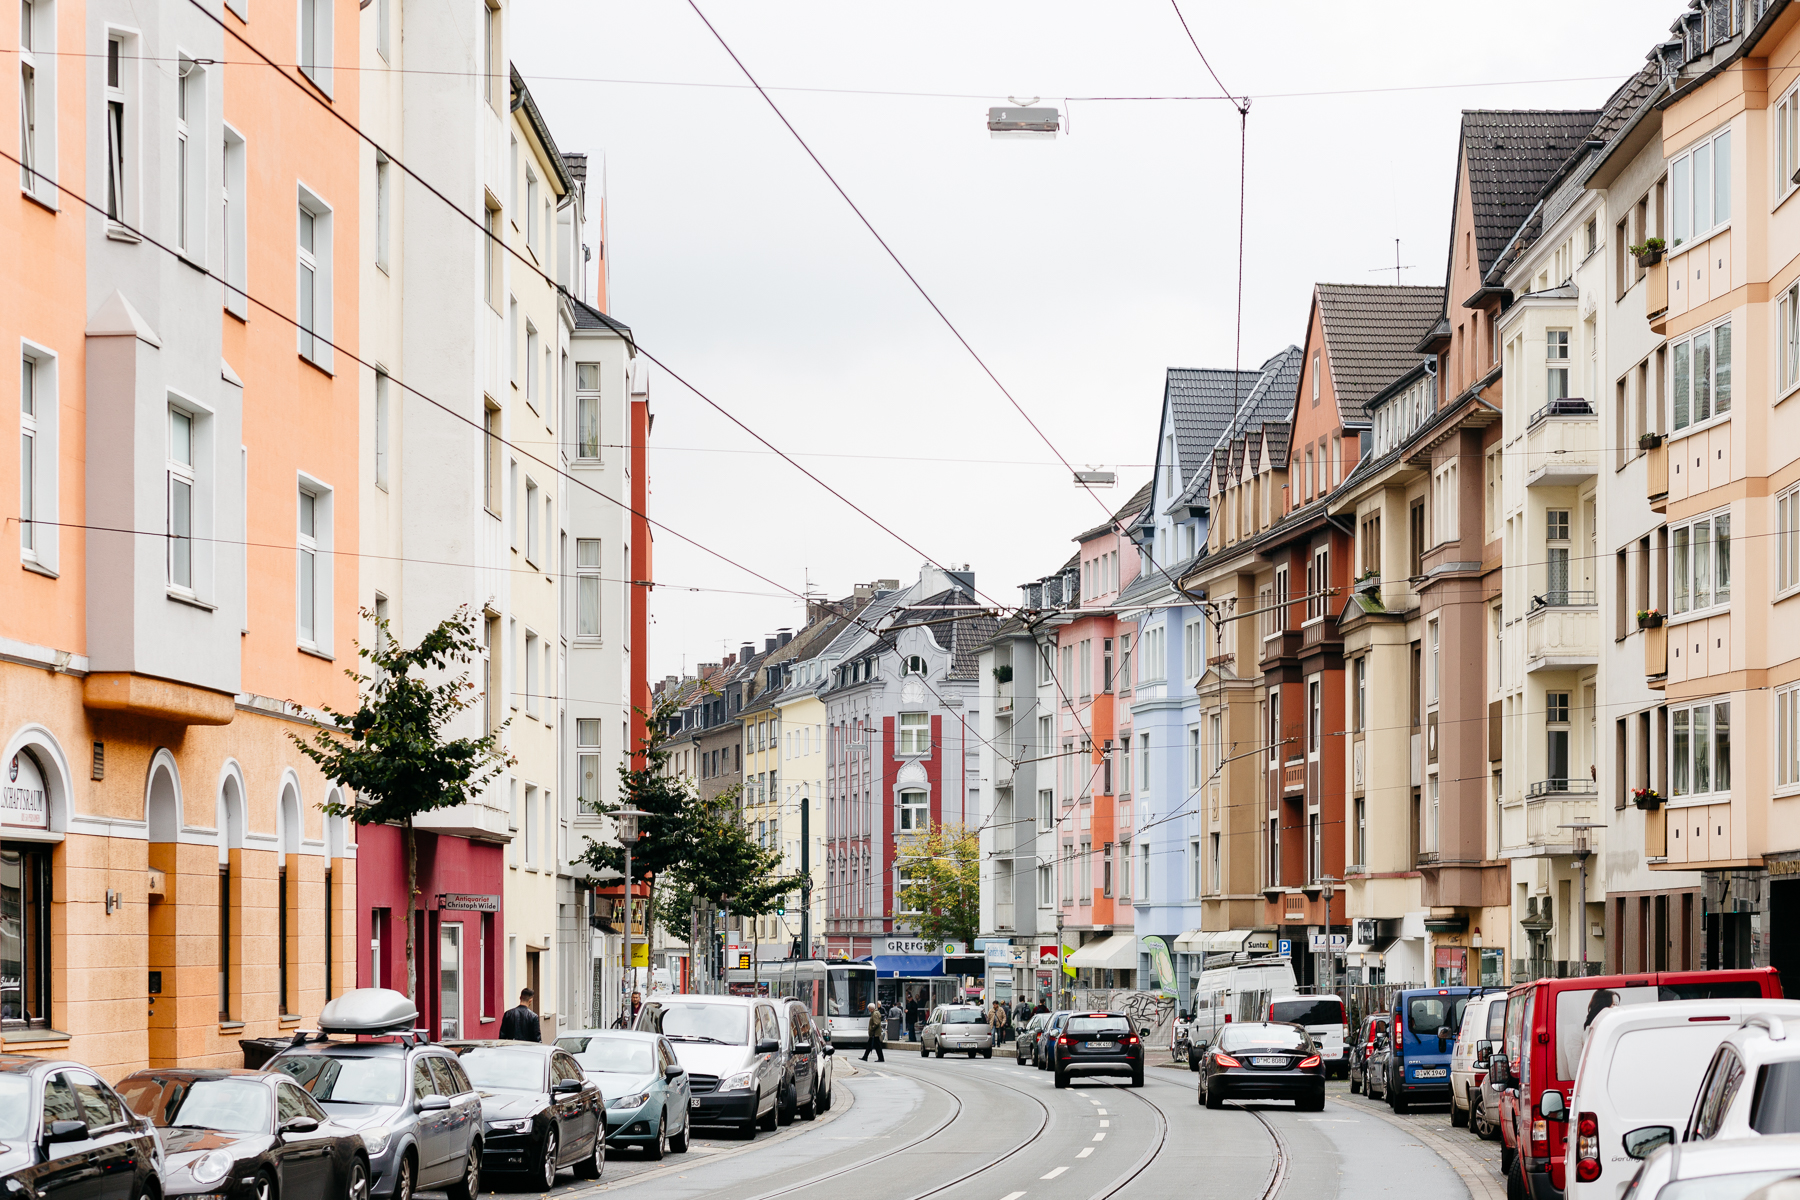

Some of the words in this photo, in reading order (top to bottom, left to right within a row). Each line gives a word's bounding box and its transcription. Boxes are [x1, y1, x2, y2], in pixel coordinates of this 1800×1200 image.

[455, 895, 489, 903] Antiquariat
[447, 901, 478, 909] Christoph
[1248, 941, 1269, 949] Suntex
